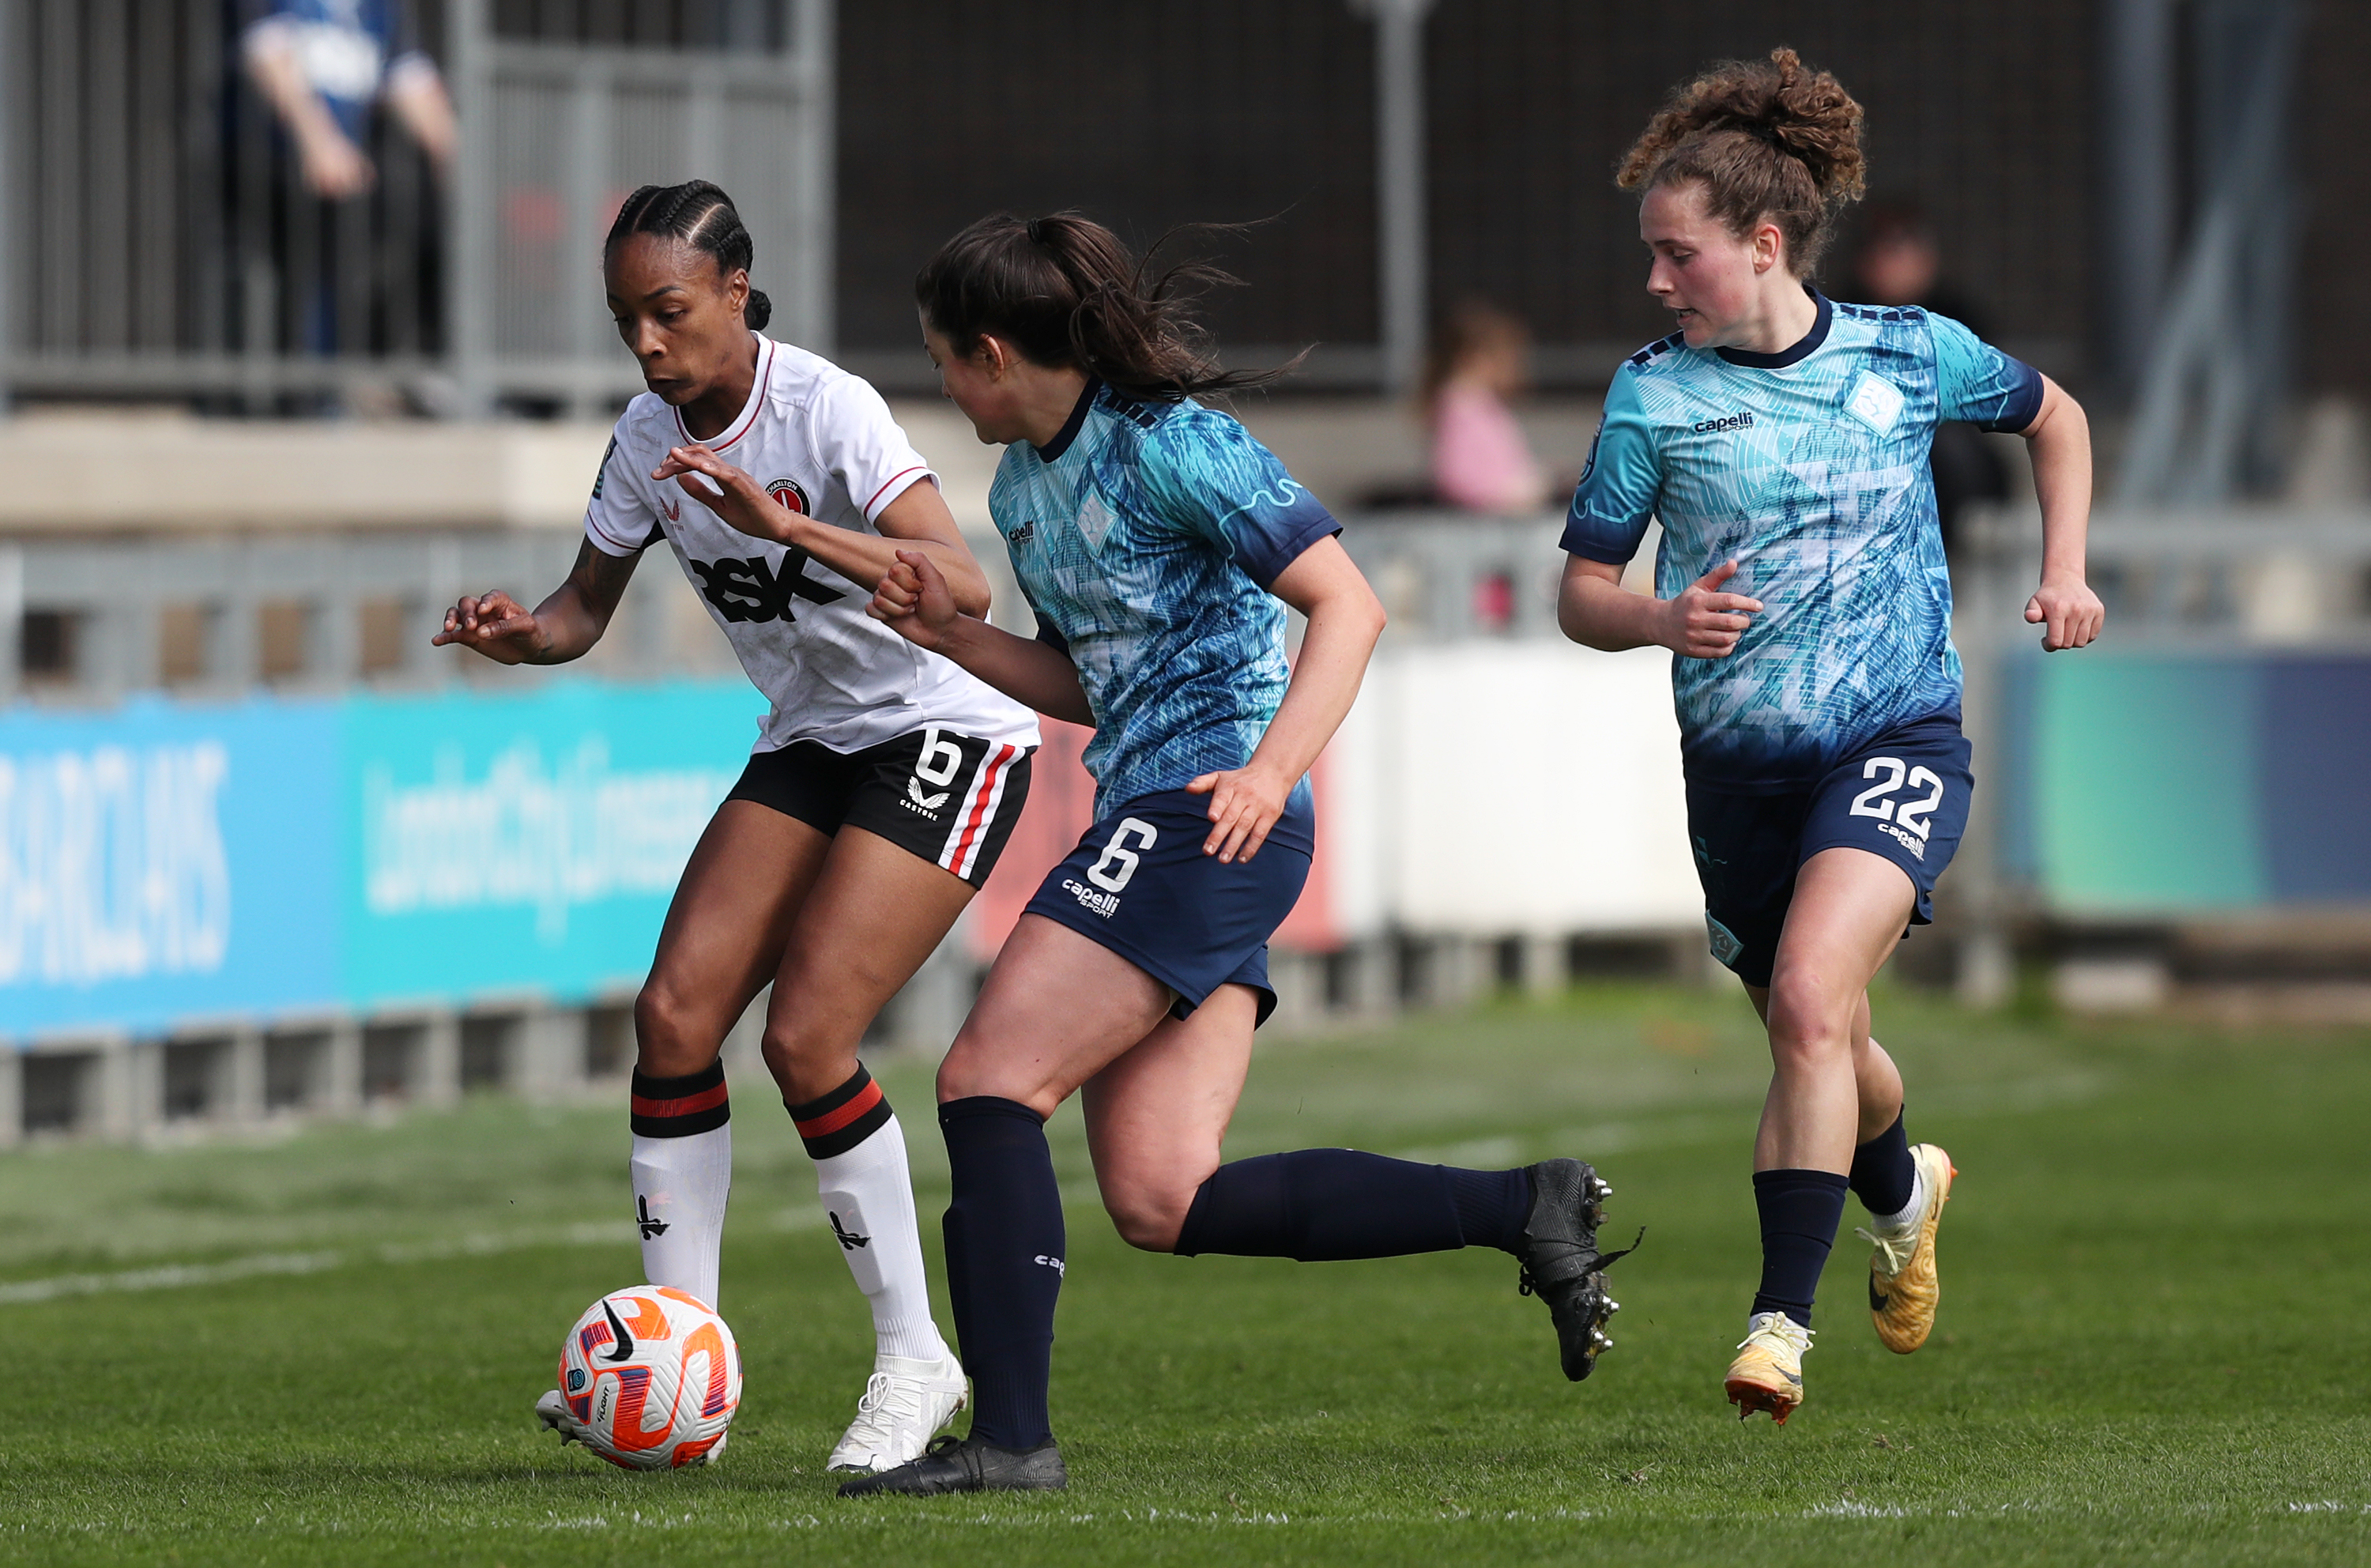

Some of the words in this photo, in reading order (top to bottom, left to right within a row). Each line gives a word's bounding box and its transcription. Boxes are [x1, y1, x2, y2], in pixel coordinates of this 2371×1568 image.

[1694, 412, 1754, 433] capelli
[767, 481, 797, 495] CHARLTON
[915, 729, 963, 787] 6
[899, 799, 939, 823] CASTORE
[1849, 756, 1944, 843] 22
[1087, 816, 1159, 893] 6
[1877, 823, 1925, 858] capelli
[1061, 879, 1121, 914] capelli
[1080, 899, 1114, 919] SPORT
[598, 1384, 610, 1422] FLIGHT
